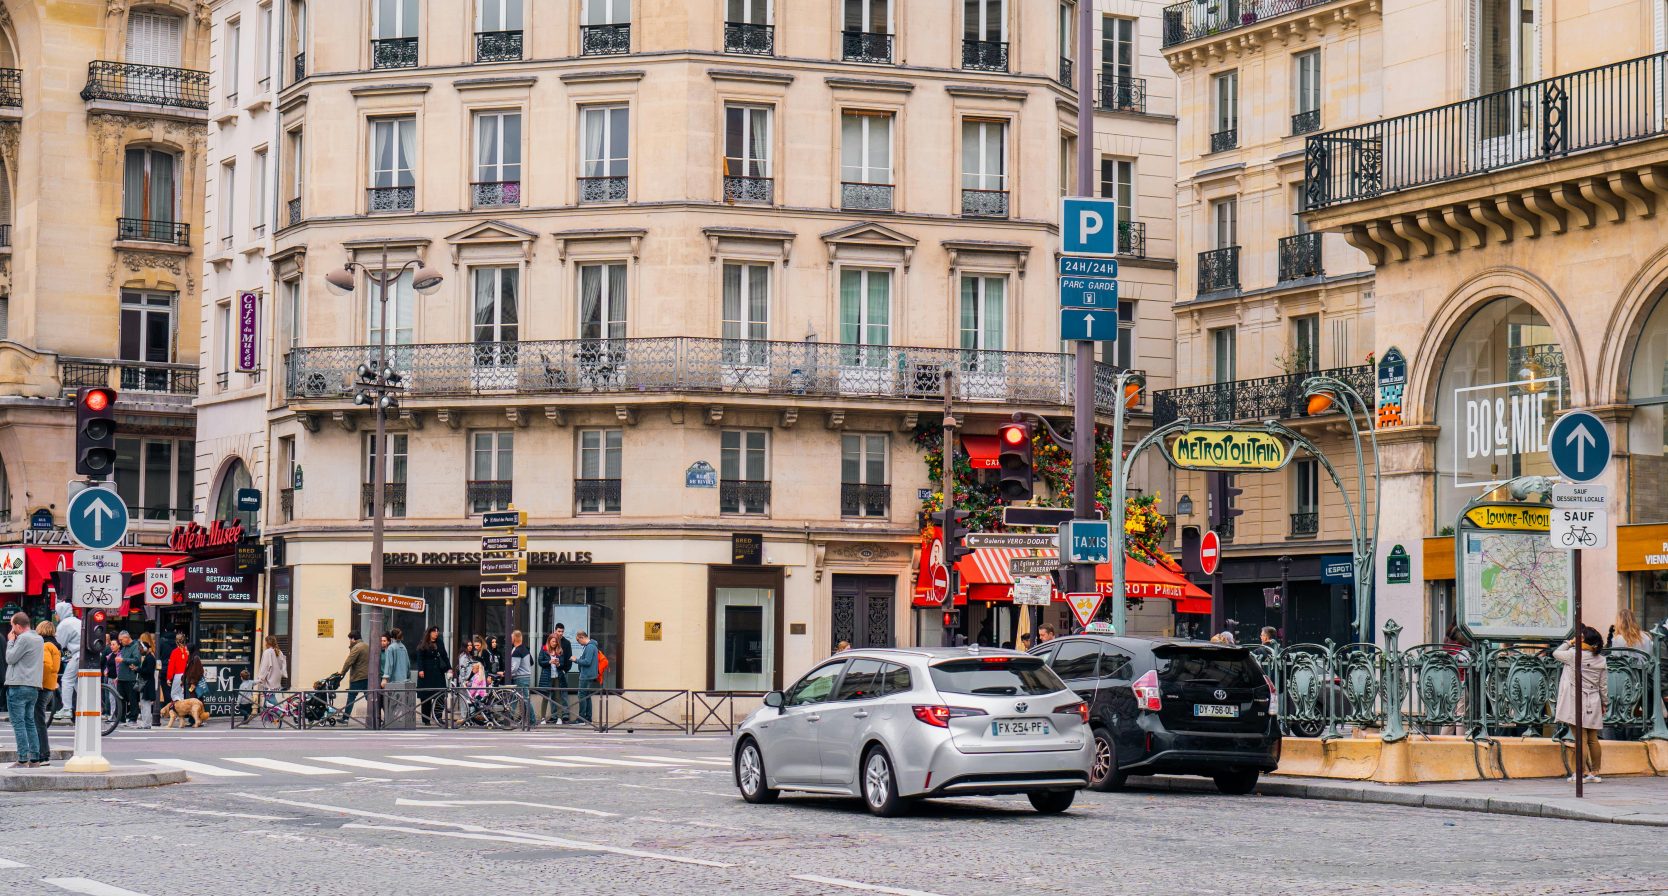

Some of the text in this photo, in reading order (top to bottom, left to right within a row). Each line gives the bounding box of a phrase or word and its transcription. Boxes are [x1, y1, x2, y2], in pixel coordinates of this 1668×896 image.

[1080, 210, 1103, 244] P
[1065, 261, 1114, 274] 24H/24H
[1063, 280, 1115, 291] PARC GARDÉ
[243, 294, 253, 325] Café
[241, 334, 254, 367] Musée
[1178, 434, 1281, 465] METROPOLITAIN
[1564, 511, 1595, 522] SAUF
[23, 530, 73, 545] PIZZA
[170, 521, 198, 552] Café
[207, 517, 243, 546] Musée
[1074, 535, 1107, 548] TAXIS
[382, 552, 419, 564] BRED
[85, 574, 111, 583] SAUF
[154, 586, 165, 595] 30
[188, 592, 222, 600] SANDWICHS
[1154, 583, 1182, 597] PARISIEN
[362, 594, 379, 602] Temple
[218, 695, 227, 703] du
[210, 704, 241, 715] PARS
[998, 721, 1042, 733] FX-254-PF
